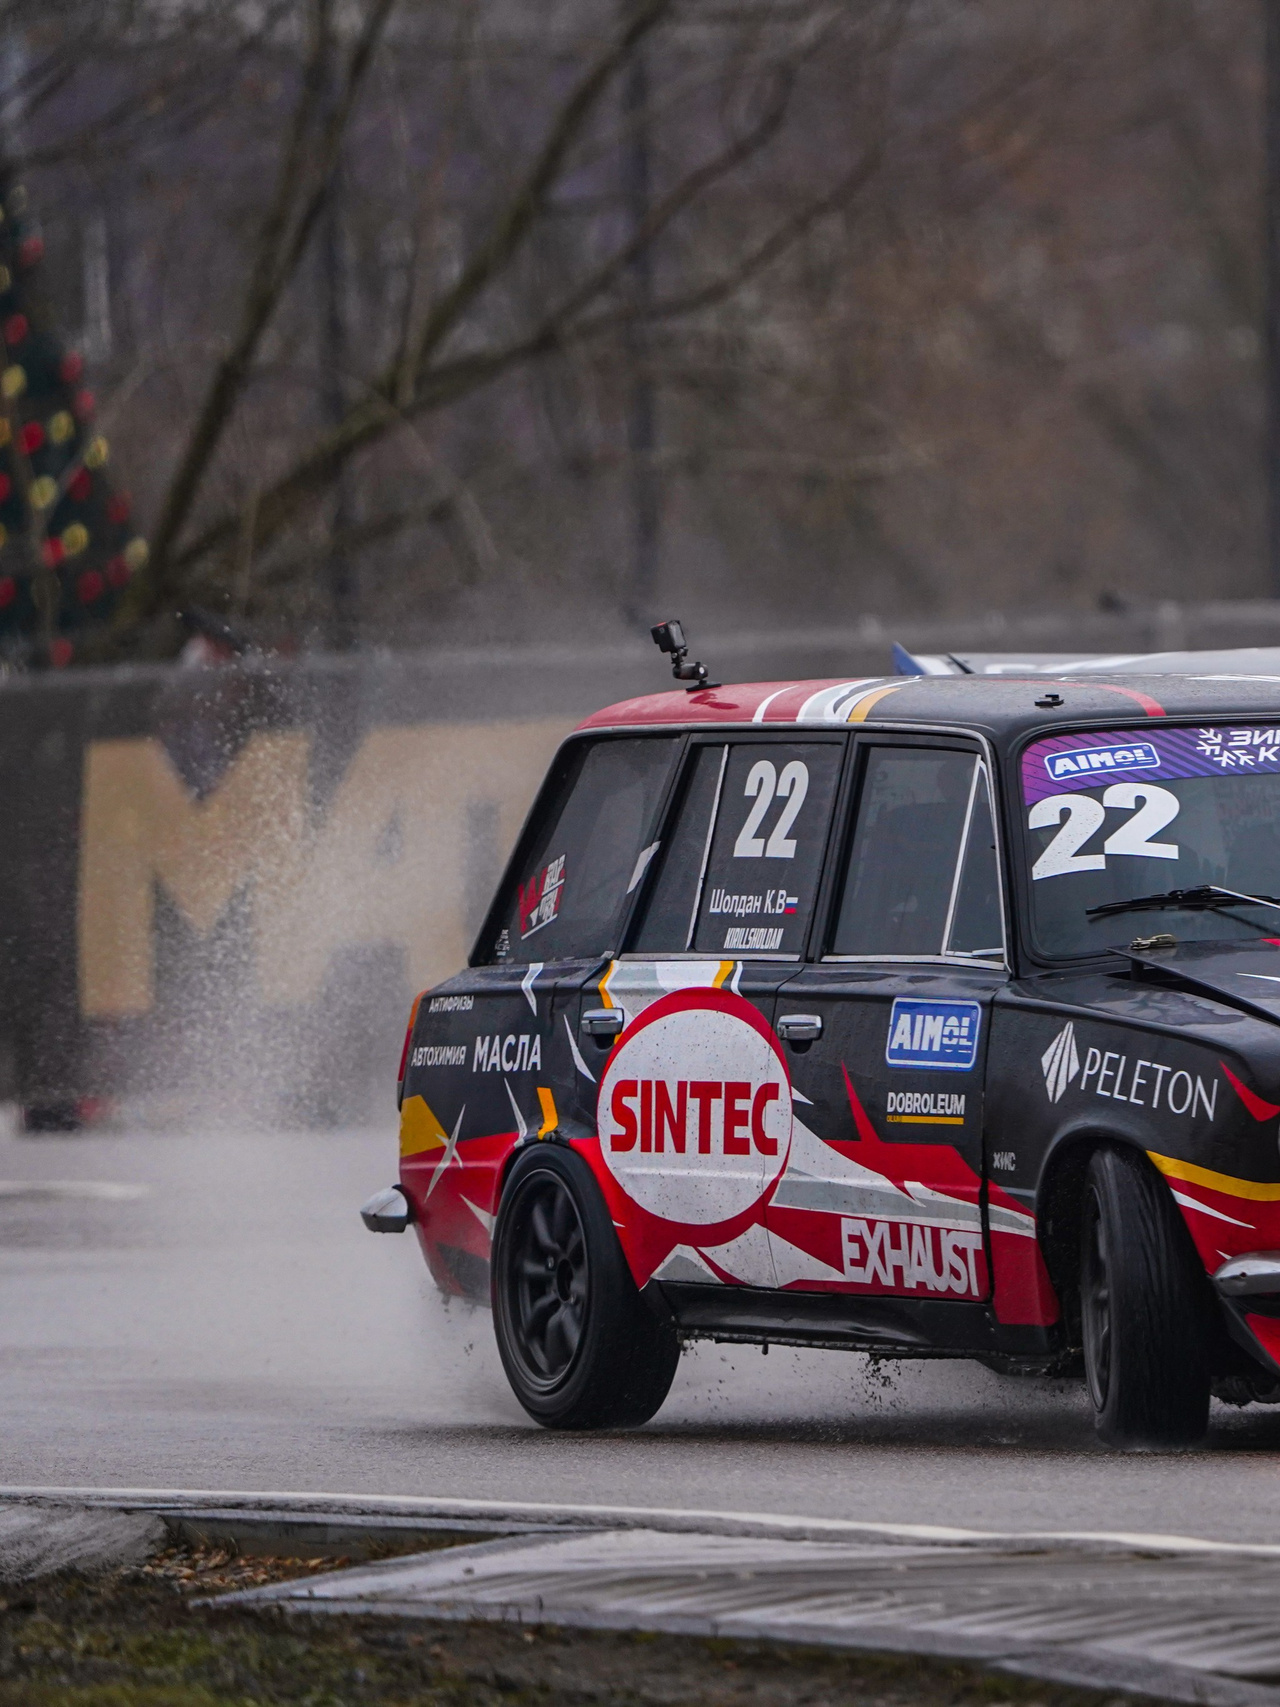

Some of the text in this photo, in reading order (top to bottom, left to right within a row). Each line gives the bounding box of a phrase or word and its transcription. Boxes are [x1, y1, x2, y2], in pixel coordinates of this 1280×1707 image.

[1054, 748, 1154, 775] AIMOL
[733, 760, 810, 859] 22
[1028, 782, 1180, 881] 22
[709, 889, 763, 917] Шолдан
[428, 995, 475, 1013] АНТИФРИЗЫ
[890, 1013, 973, 1053] AIMOL
[411, 1034, 542, 1073] АВТОХИМИЯ МАСЛА
[886, 1091, 966, 1115] DOBROLEUM
[1080, 1047, 1219, 1122] PELETON
[610, 1079, 780, 1156] SINTEC
[840, 1217, 983, 1297] EXHAUST
